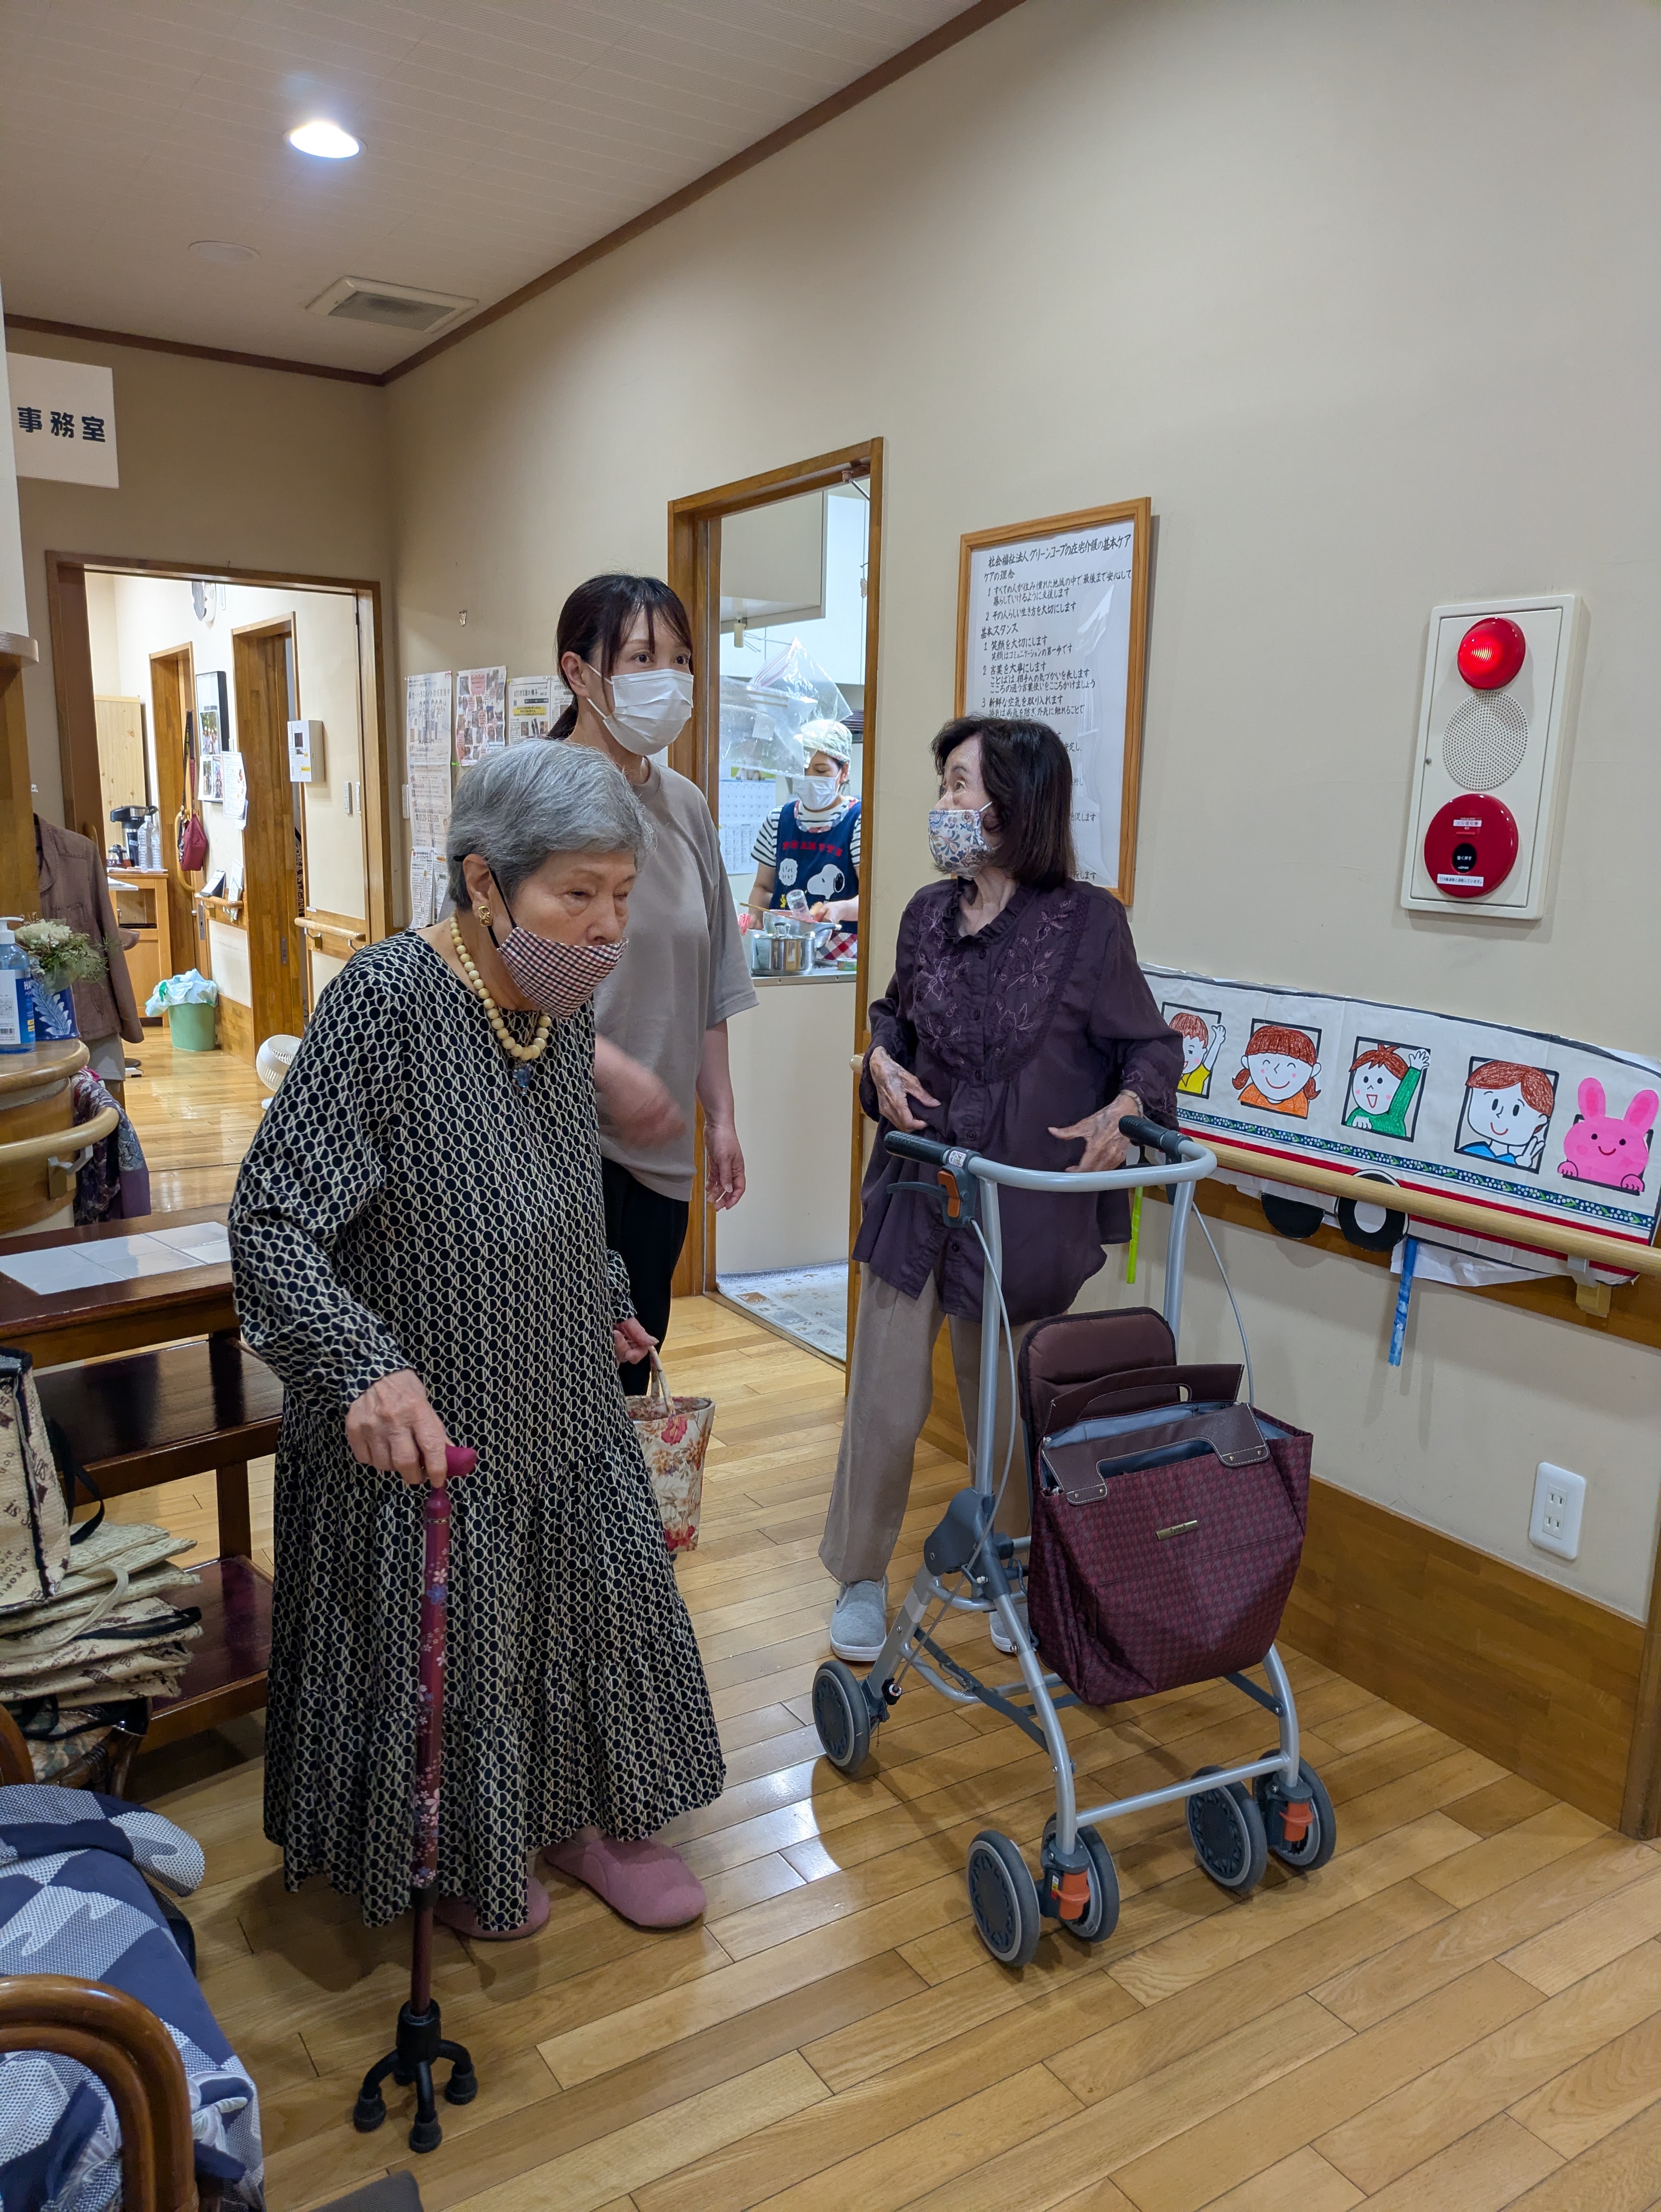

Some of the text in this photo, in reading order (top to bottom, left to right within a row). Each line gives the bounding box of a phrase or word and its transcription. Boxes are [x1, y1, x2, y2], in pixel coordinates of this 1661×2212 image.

[17, 407, 106, 442] 事務室
[984, 569, 1015, 583] ケアの理念
[993, 587, 1070, 607] 暮らしていけるように支援します
[993, 601, 1076, 621] その人らしい生き方を大切にします
[981, 623, 1019, 639] 基本スタンス
[991, 635, 1048, 651] 笑顔を大切にします
[991, 661, 1046, 675] 言葉を大事にします
[989, 694, 1063, 708] 新鮮な空気を取り入れます
[783, 841, 842, 857] PEANUTS
